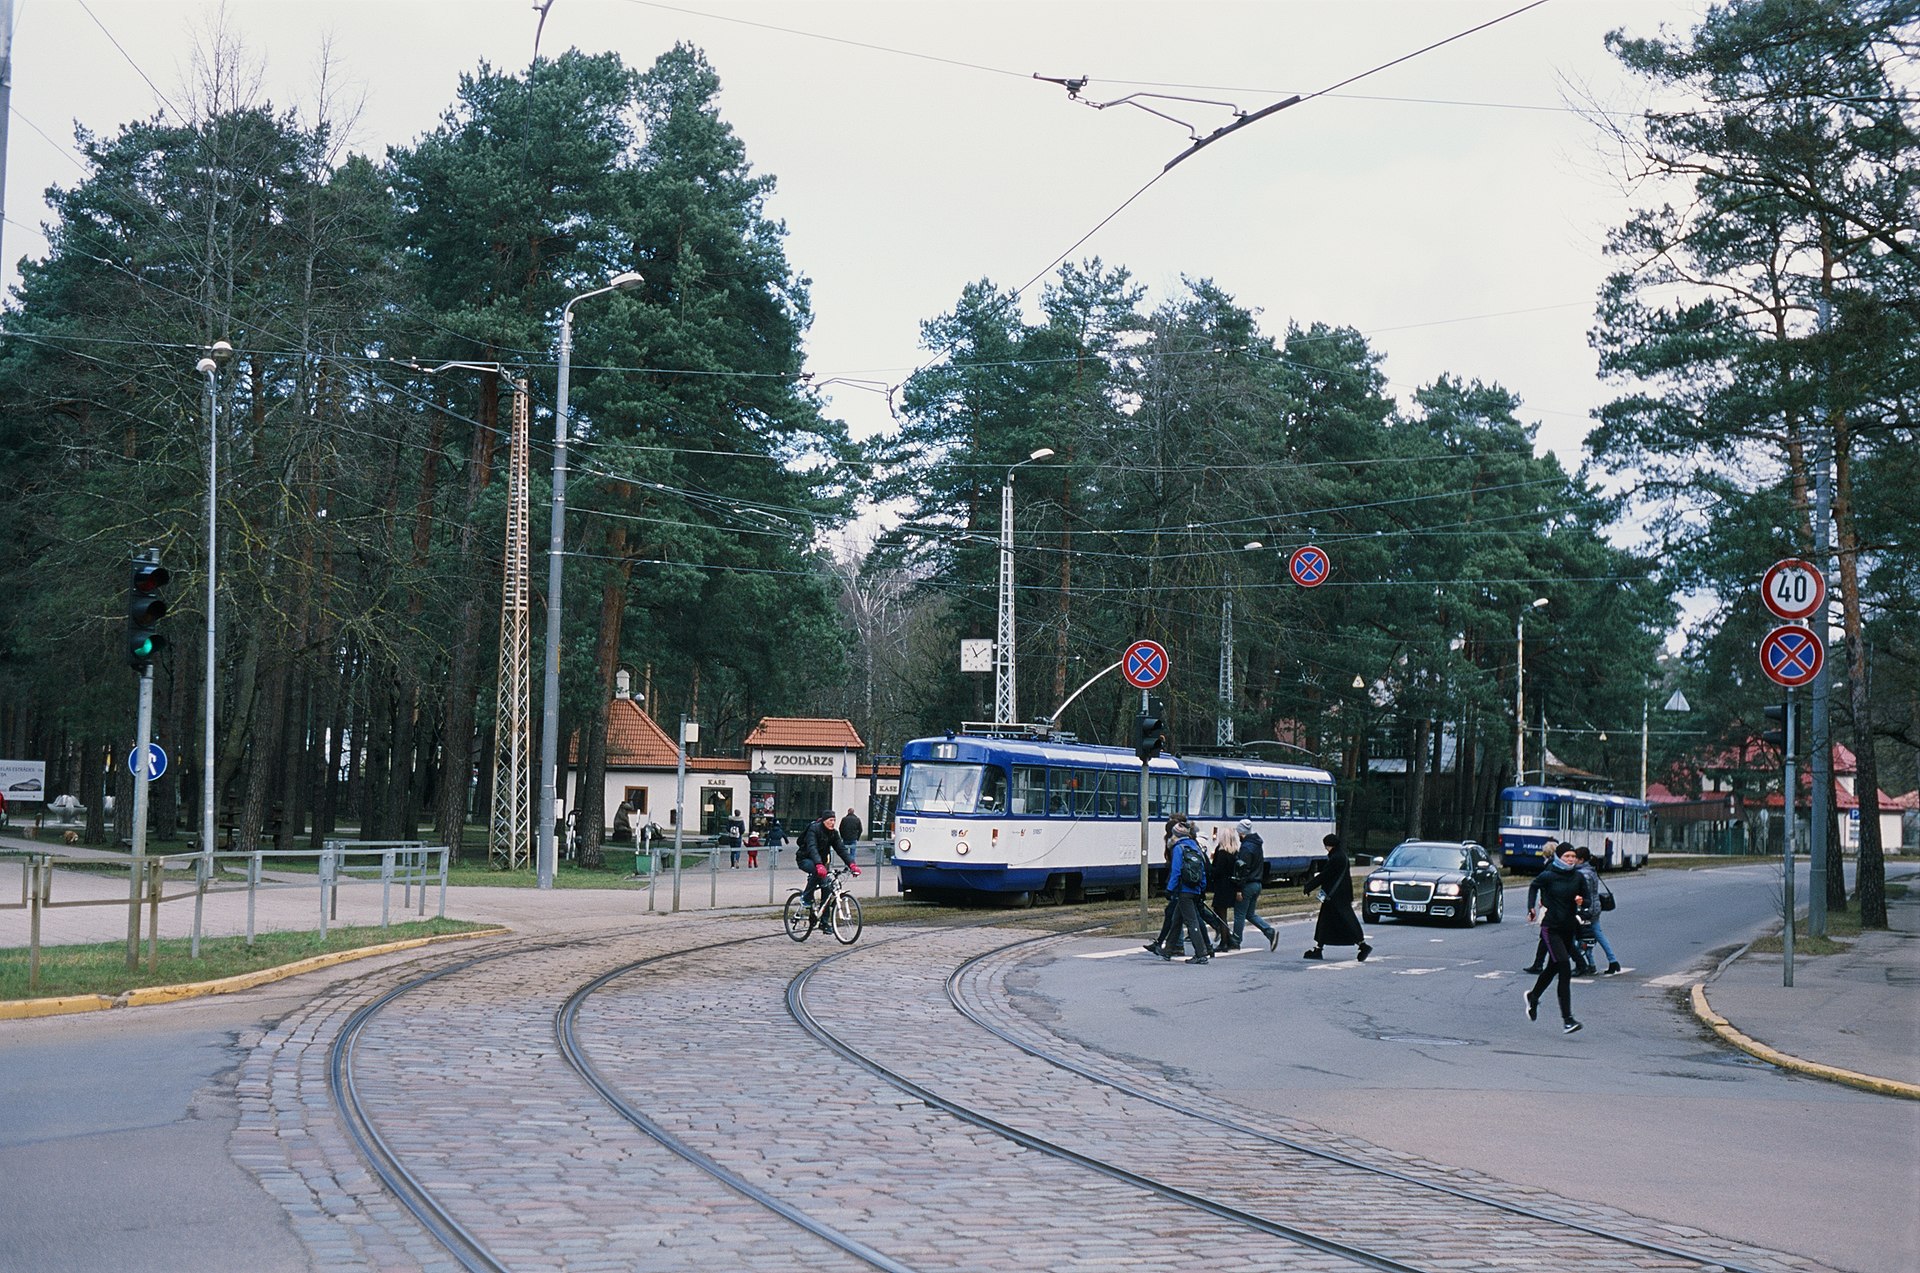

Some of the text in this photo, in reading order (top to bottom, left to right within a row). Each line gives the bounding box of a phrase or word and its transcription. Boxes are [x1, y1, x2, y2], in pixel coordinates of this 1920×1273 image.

[1777, 574, 1807, 603] 40
[937, 743, 954, 758] 11
[773, 755, 834, 767] ZOODĀRZS
